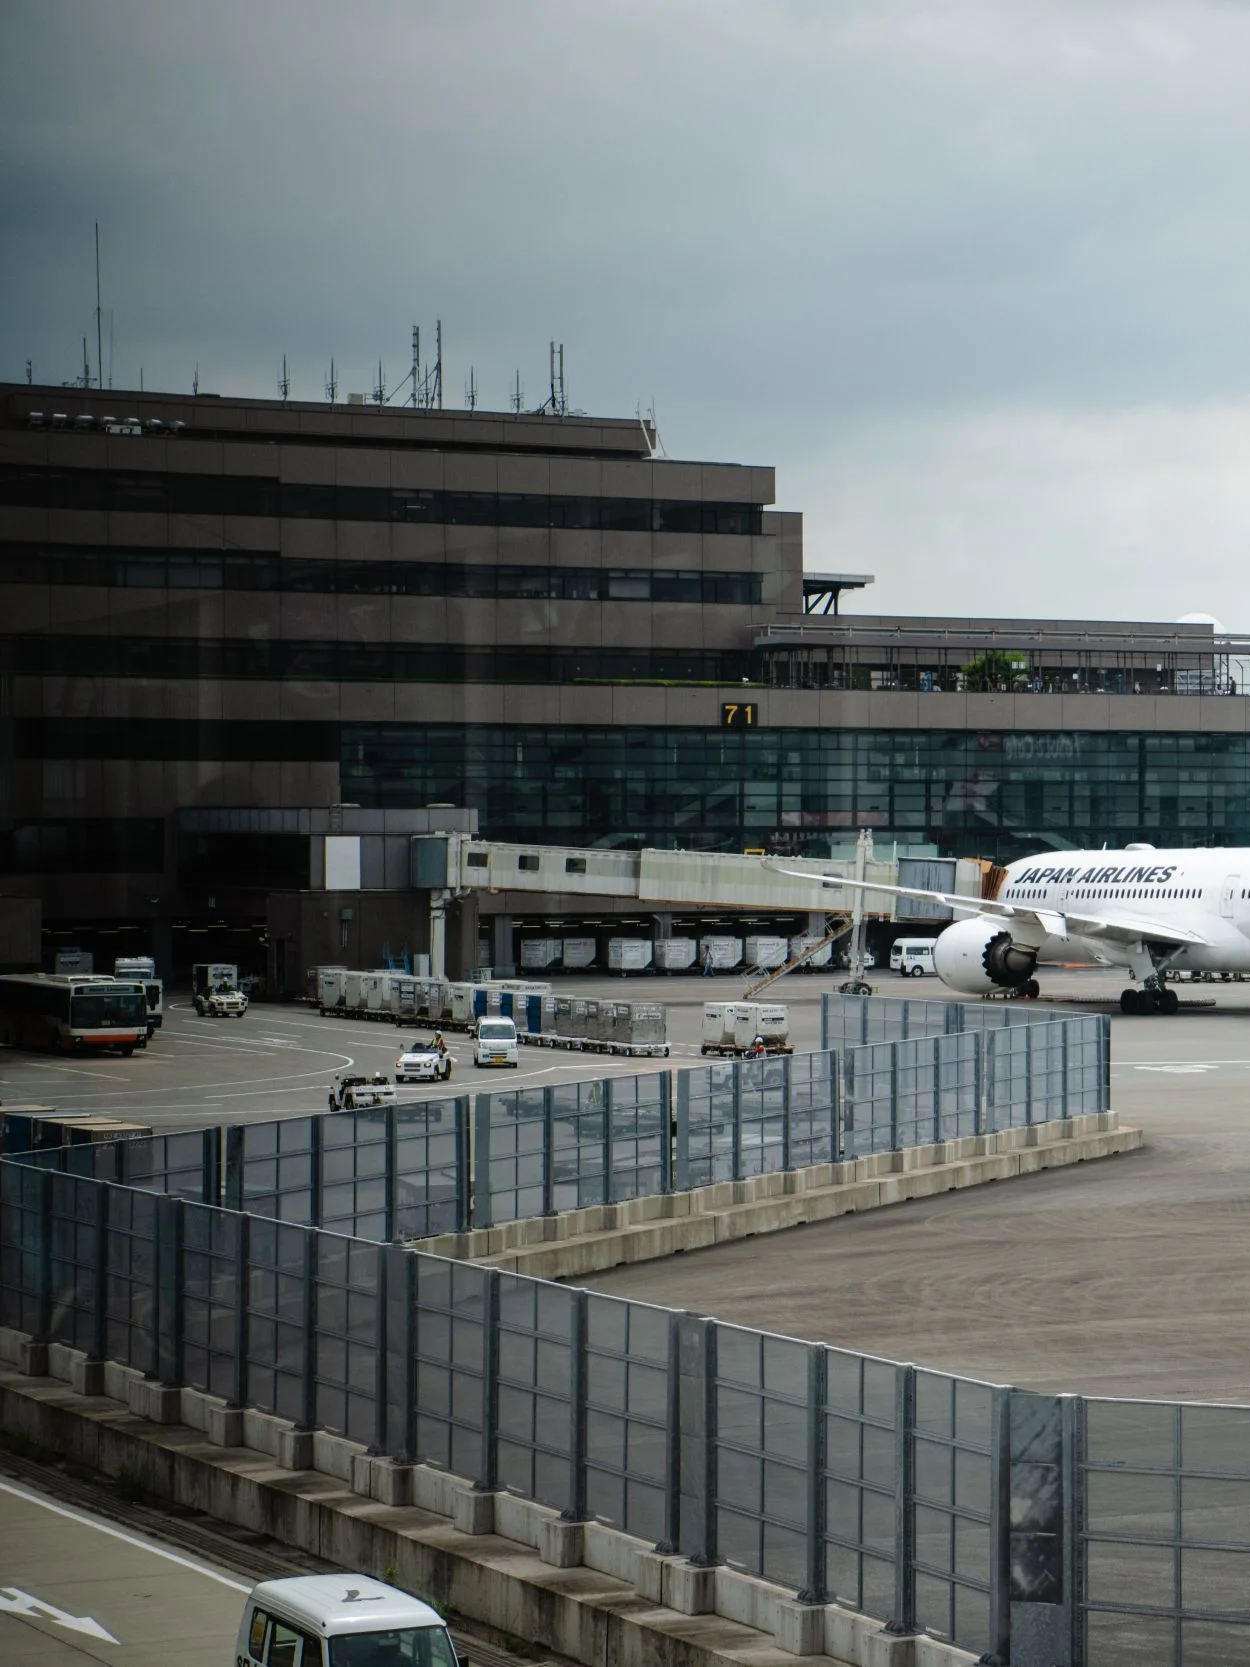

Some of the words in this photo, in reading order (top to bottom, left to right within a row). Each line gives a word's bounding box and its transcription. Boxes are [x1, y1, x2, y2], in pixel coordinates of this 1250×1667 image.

[724, 705, 753, 724] 71
[1014, 867, 1081, 884] JAPAN
[1077, 866, 1177, 884] AIRLINES
